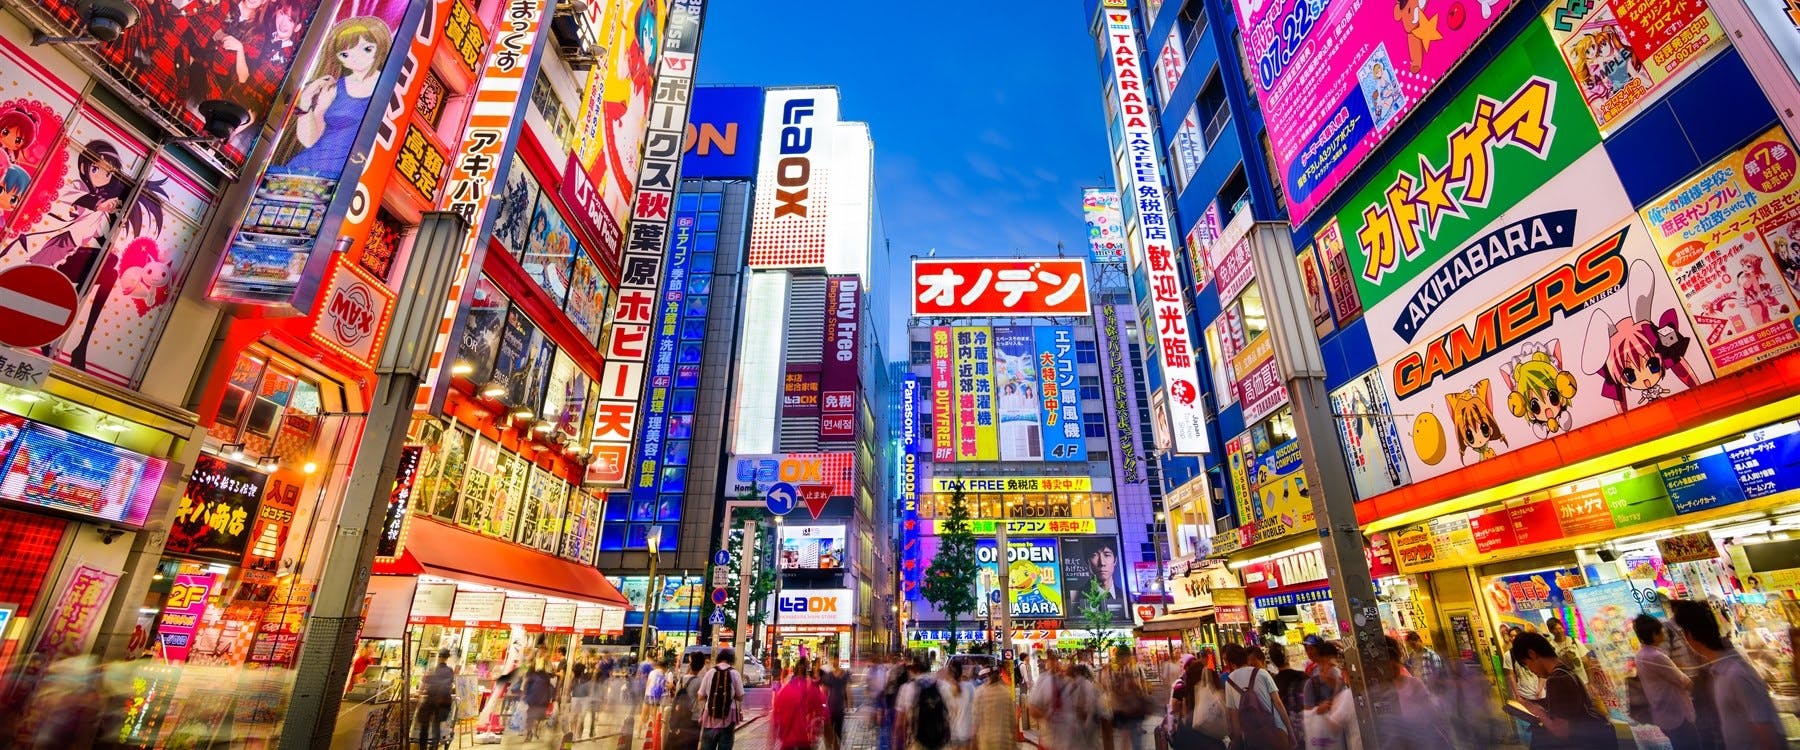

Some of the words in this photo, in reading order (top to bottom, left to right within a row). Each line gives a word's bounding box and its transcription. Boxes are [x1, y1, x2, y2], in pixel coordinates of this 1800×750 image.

[1113, 34, 1147, 128] TAKARADA
[1587, 48, 1631, 90] SAMPLE
[1138, 186, 1167, 240] 免税商店
[918, 262, 1081, 308] オノデン
[1409, 219, 1552, 329] AKIHABARA
[839, 280, 858, 319] Duty
[1393, 224, 1631, 400] GAMERS
[836, 320, 854, 362] Free
[825, 395, 852, 408] 免税
[904, 380, 915, 445] Panasonic
[266, 479, 300, 507] 入口
[806, 491, 828, 500] 止まれ
[905, 453, 915, 511] ONODEN
[940, 480, 966, 490] TAX
[970, 480, 1005, 490] FREE
[1007, 479, 1038, 490] 免税店
[261, 505, 293, 524] はコチラ
[1007, 521, 1046, 531] エアコン
[1262, 524, 1286, 540] MOBILES
[167, 584, 208, 610] 2F
[979, 602, 1059, 615] AABARA
